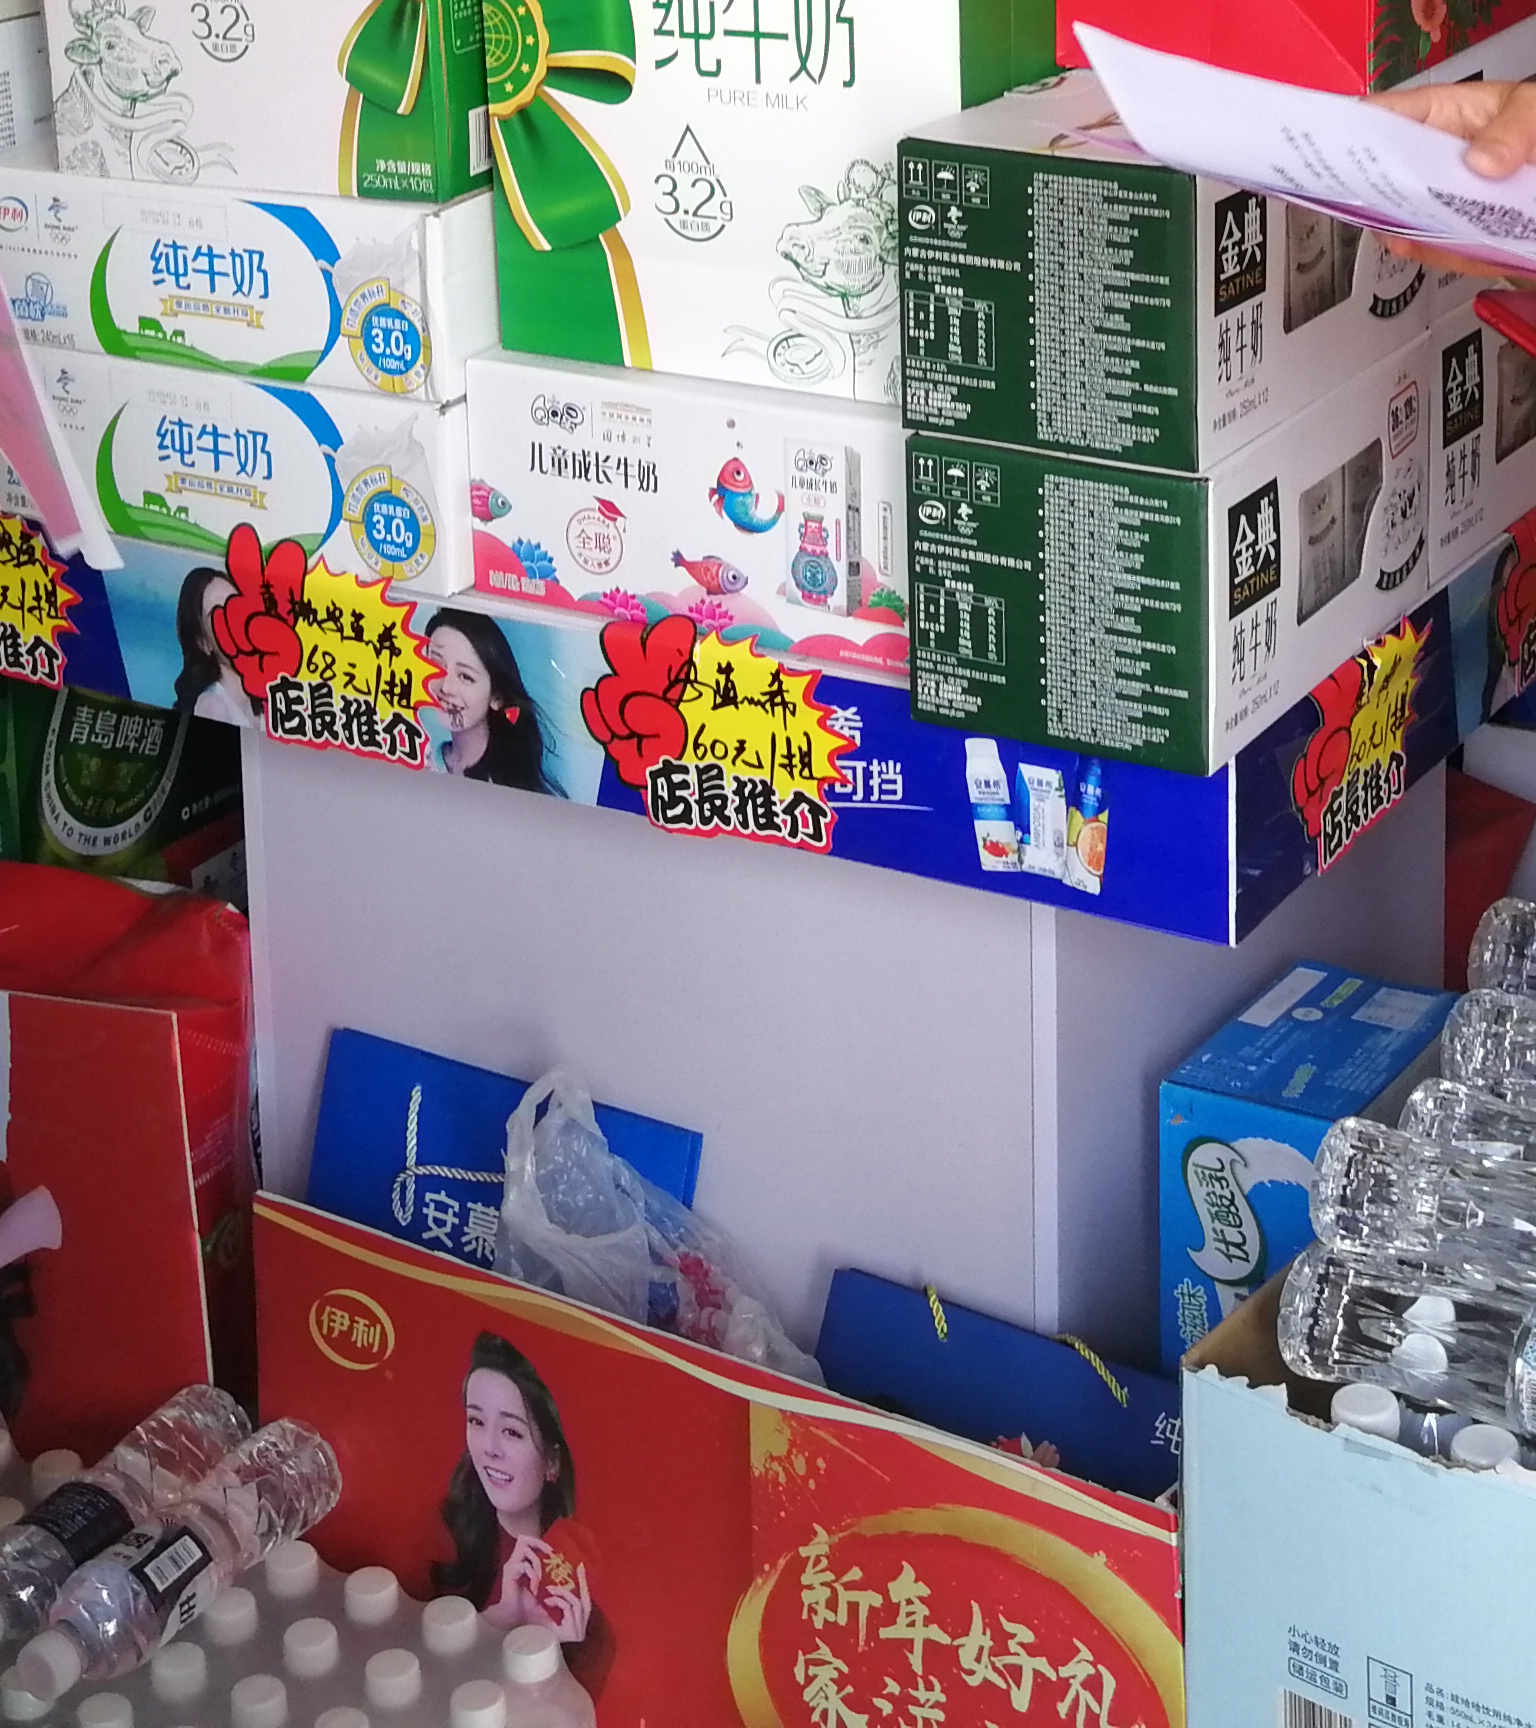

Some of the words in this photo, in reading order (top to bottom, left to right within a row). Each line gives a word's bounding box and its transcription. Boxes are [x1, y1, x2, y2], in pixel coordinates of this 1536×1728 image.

[189, 2, 256, 45] 3.2g
[706, 87, 760, 109] PURE
[764, 91, 810, 112] MILK
[374, 158, 433, 178] 净含量/规格
[653, 172, 734, 222] 3.2g
[1218, 194, 1265, 283] 金典
[149, 237, 270, 300] 纯牛奶
[1218, 267, 1265, 304] SATINE
[370, 329, 413, 360] 3.0g
[1217, 310, 1264, 385] 纯牛奶
[1444, 344, 1482, 421] 金典
[154, 415, 274, 481] 纯牛奶
[529, 441, 659, 494] 儿童成长牛奶
[1443, 435, 1482, 510] 纯牛奶
[371, 515, 413, 548] 3.0g
[574, 527, 612, 554] 全聪
[1232, 503, 1279, 586] 金典
[1232, 563, 1278, 607] SATINE
[1230, 601, 1279, 686] 纯牛奶
[268, 675, 424, 763] 店長推介
[650, 760, 831, 843] 店長推介
[77, 832, 99, 848] THE
[1191, 1156, 1251, 1264] 优酸乳
[318, 1303, 385, 1354] 伊利
[797, 1526, 1123, 1728] 新年好礼
[1287, 1624, 1341, 1657] 小心轻放
[1287, 1638, 1341, 1674] 请勿倒置
